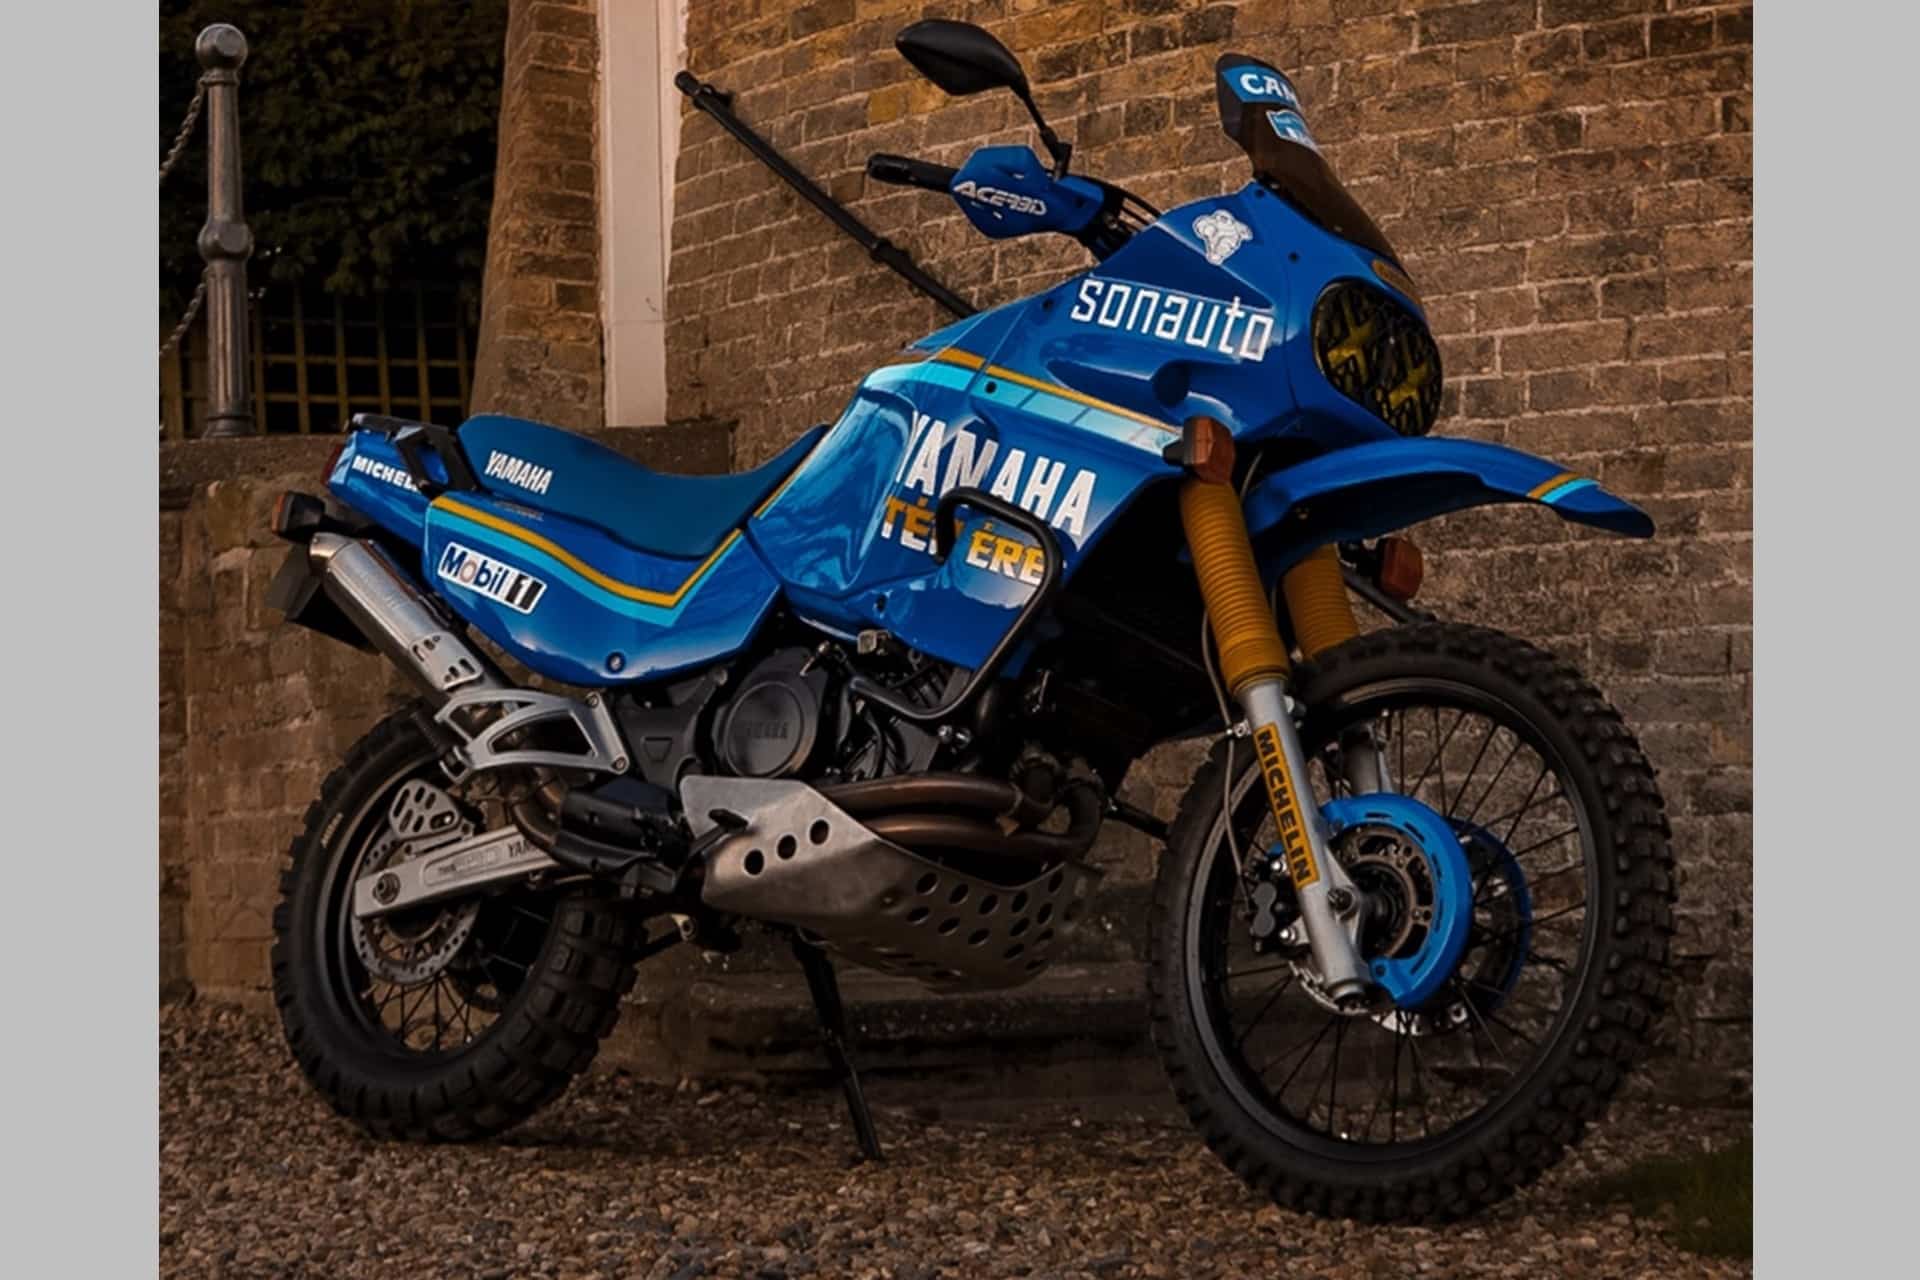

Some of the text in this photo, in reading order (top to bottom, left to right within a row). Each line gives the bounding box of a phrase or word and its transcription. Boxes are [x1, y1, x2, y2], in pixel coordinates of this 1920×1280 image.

[1070, 278, 1274, 363] sonauto
[351, 455, 418, 492] MICHEL
[484, 450, 553, 495] YAMAHA
[440, 546, 510, 595] Mobil
[1257, 728, 1312, 882] MICHELIN
